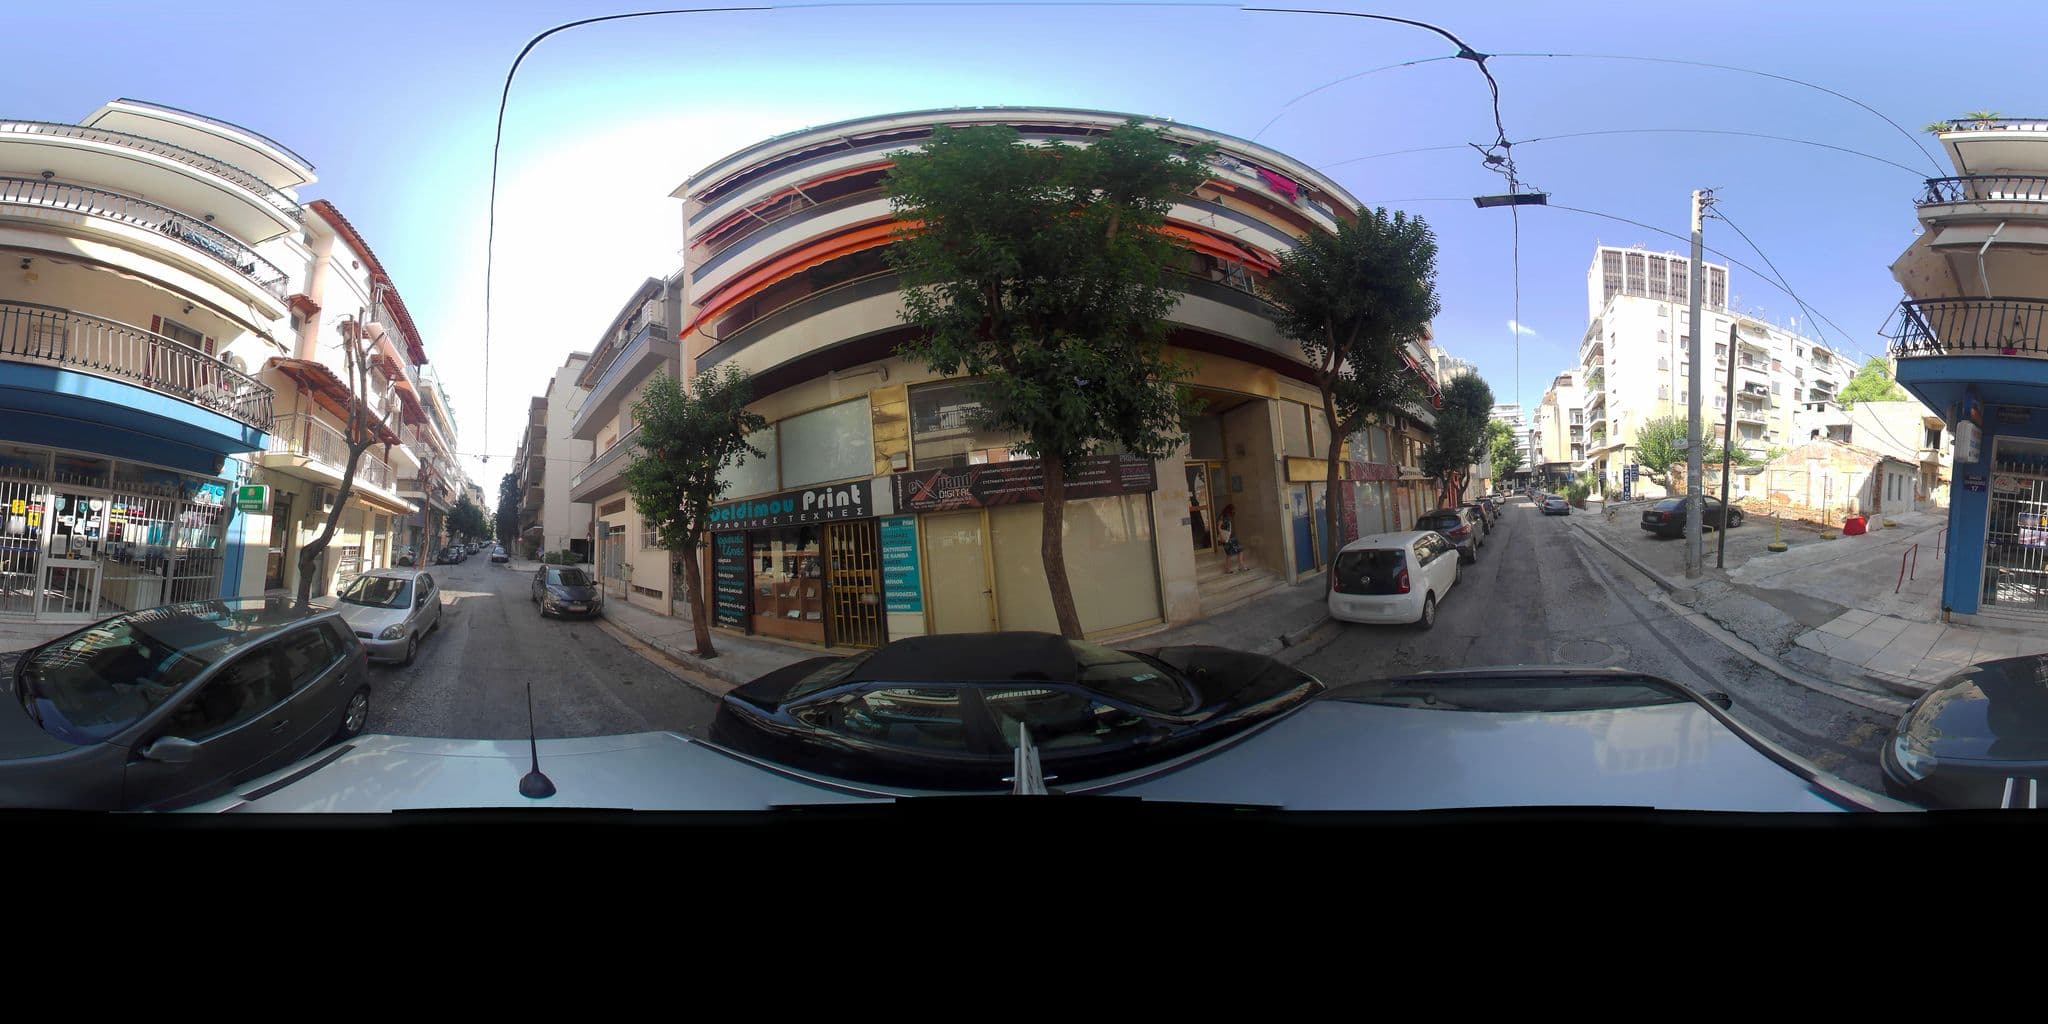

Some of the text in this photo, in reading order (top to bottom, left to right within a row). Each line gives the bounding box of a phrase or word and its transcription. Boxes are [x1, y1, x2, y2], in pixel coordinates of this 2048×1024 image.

[802, 484, 861, 511] Print
[938, 488, 973, 499] DIGITAL
[709, 506, 864, 530] ΓΡΑΦΙΚΕΣ ΤΕΧΝΕΣ
